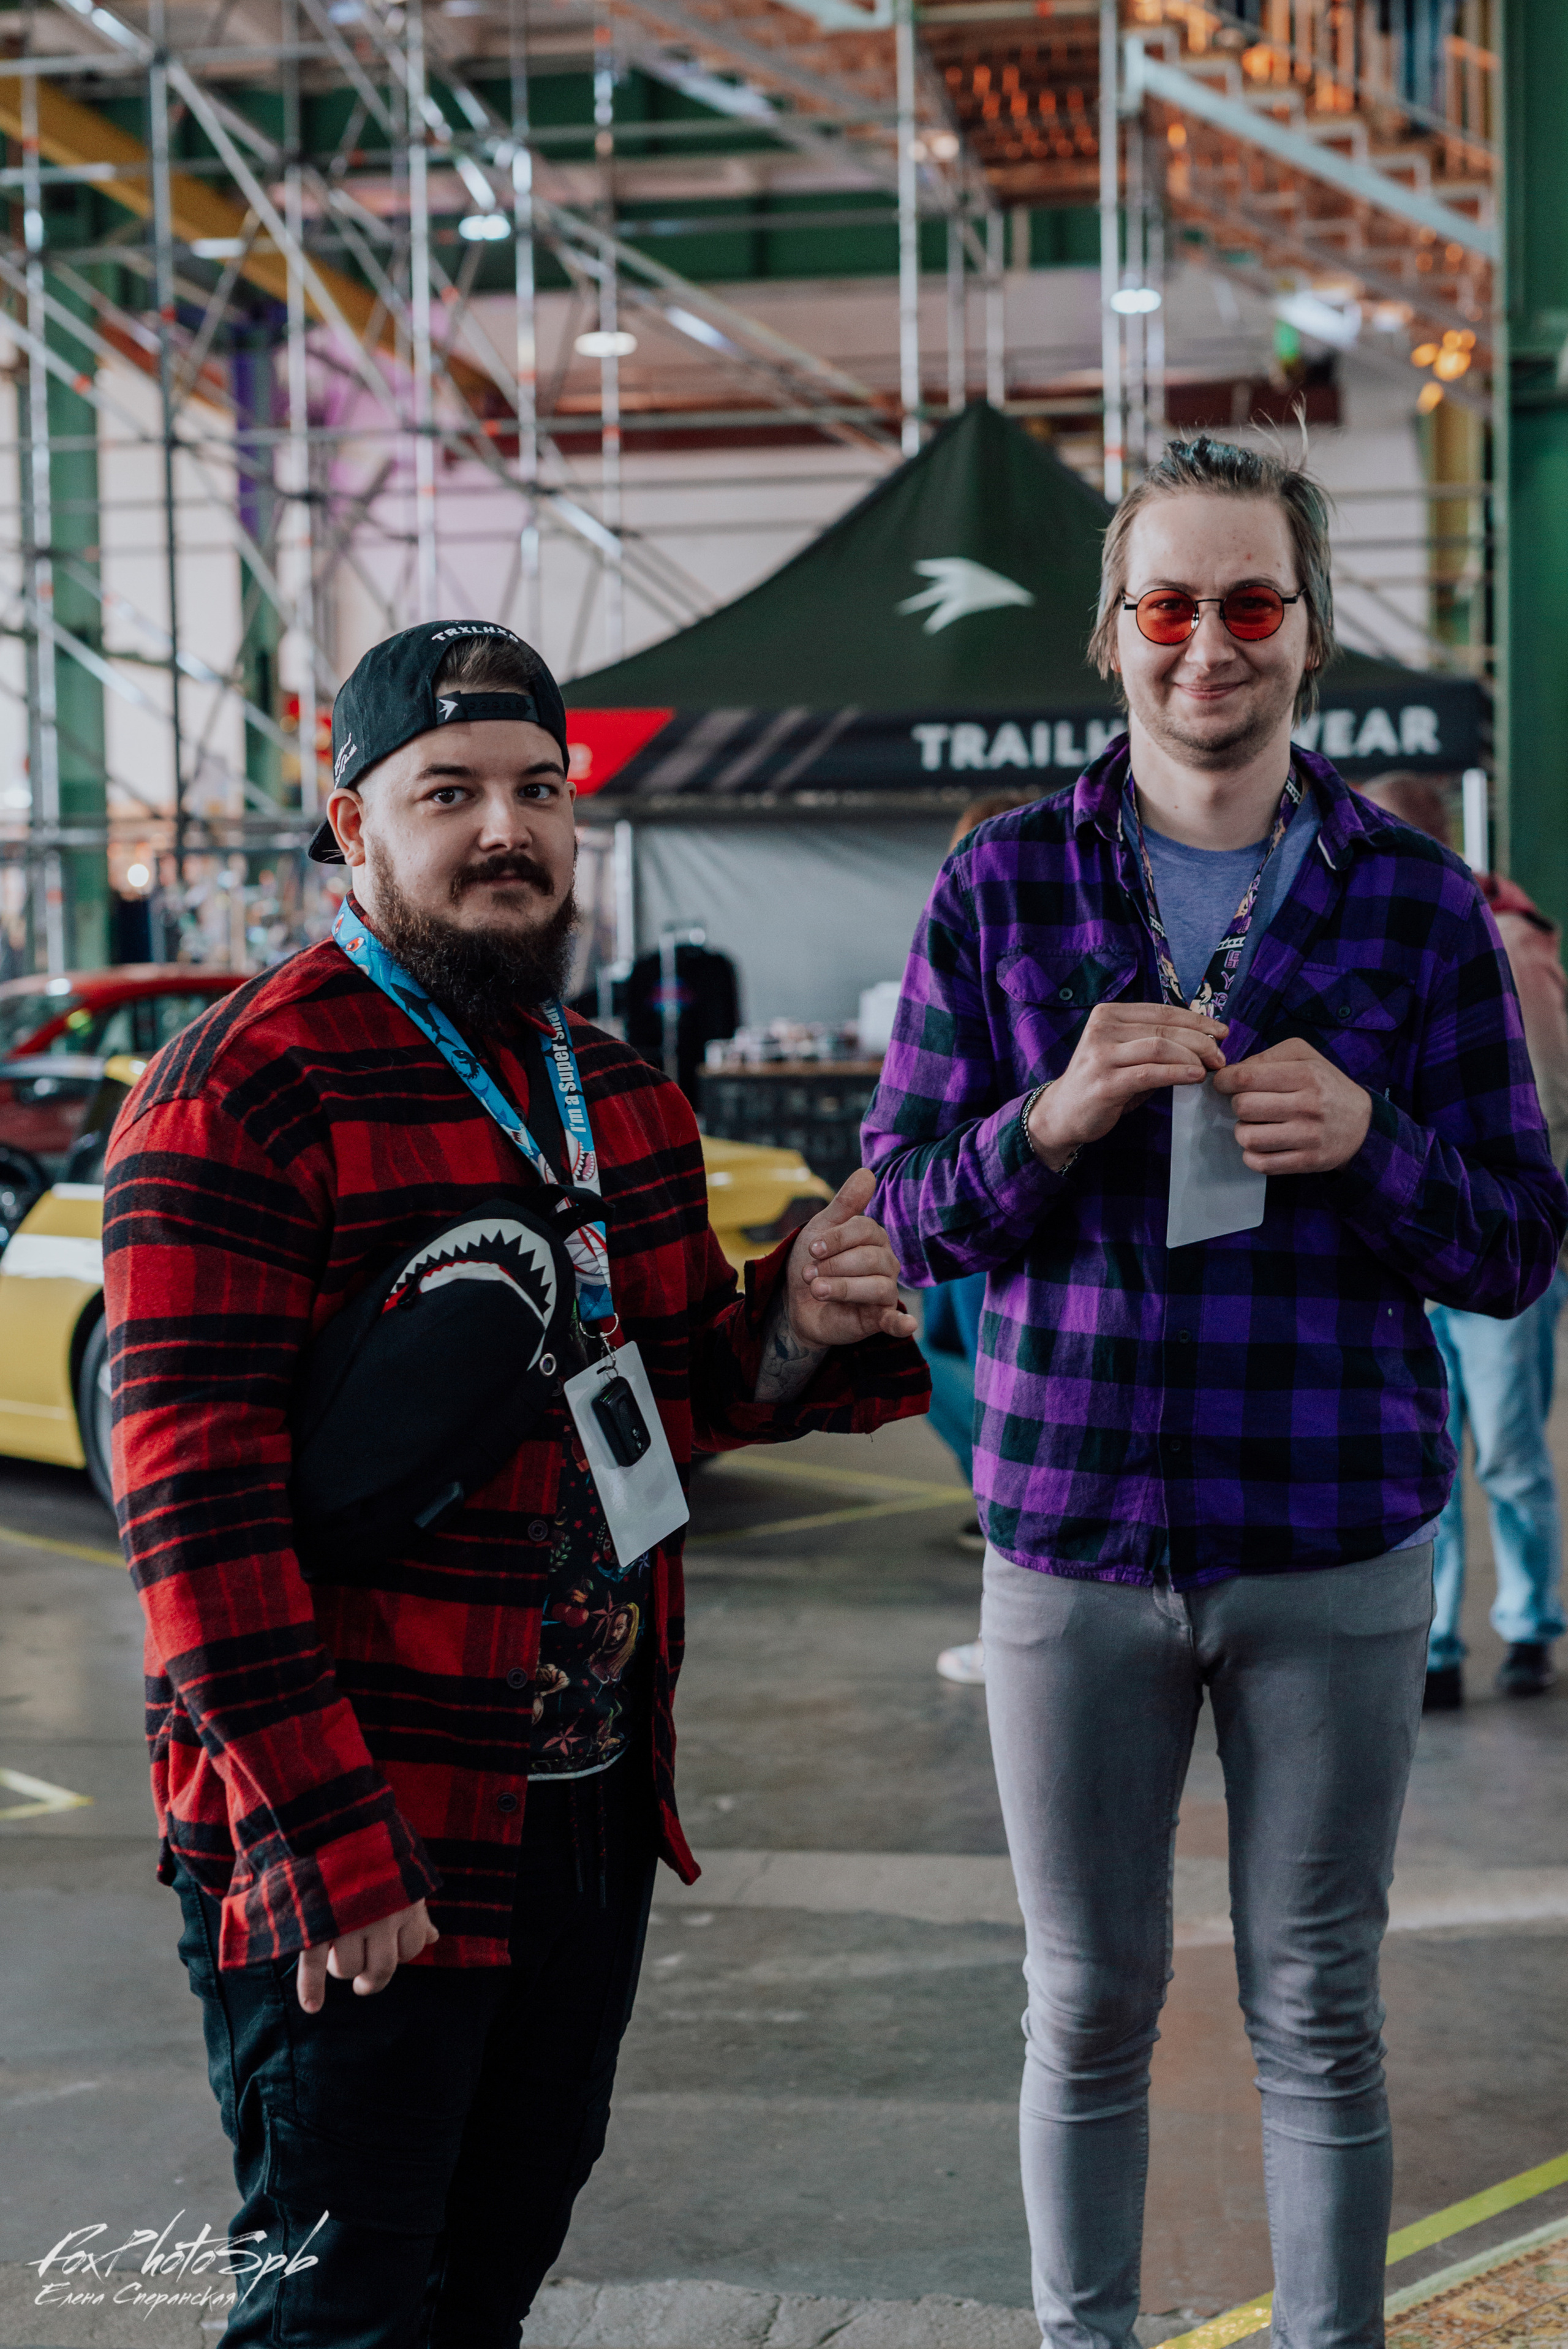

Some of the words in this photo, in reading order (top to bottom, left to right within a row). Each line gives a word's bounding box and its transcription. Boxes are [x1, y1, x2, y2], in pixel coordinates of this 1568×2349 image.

[912, 719, 1128, 772] TRAILH
[552, 1043, 577, 1092] Super
[564, 1095, 580, 1105] a
[567, 1108, 587, 1133] I'm
